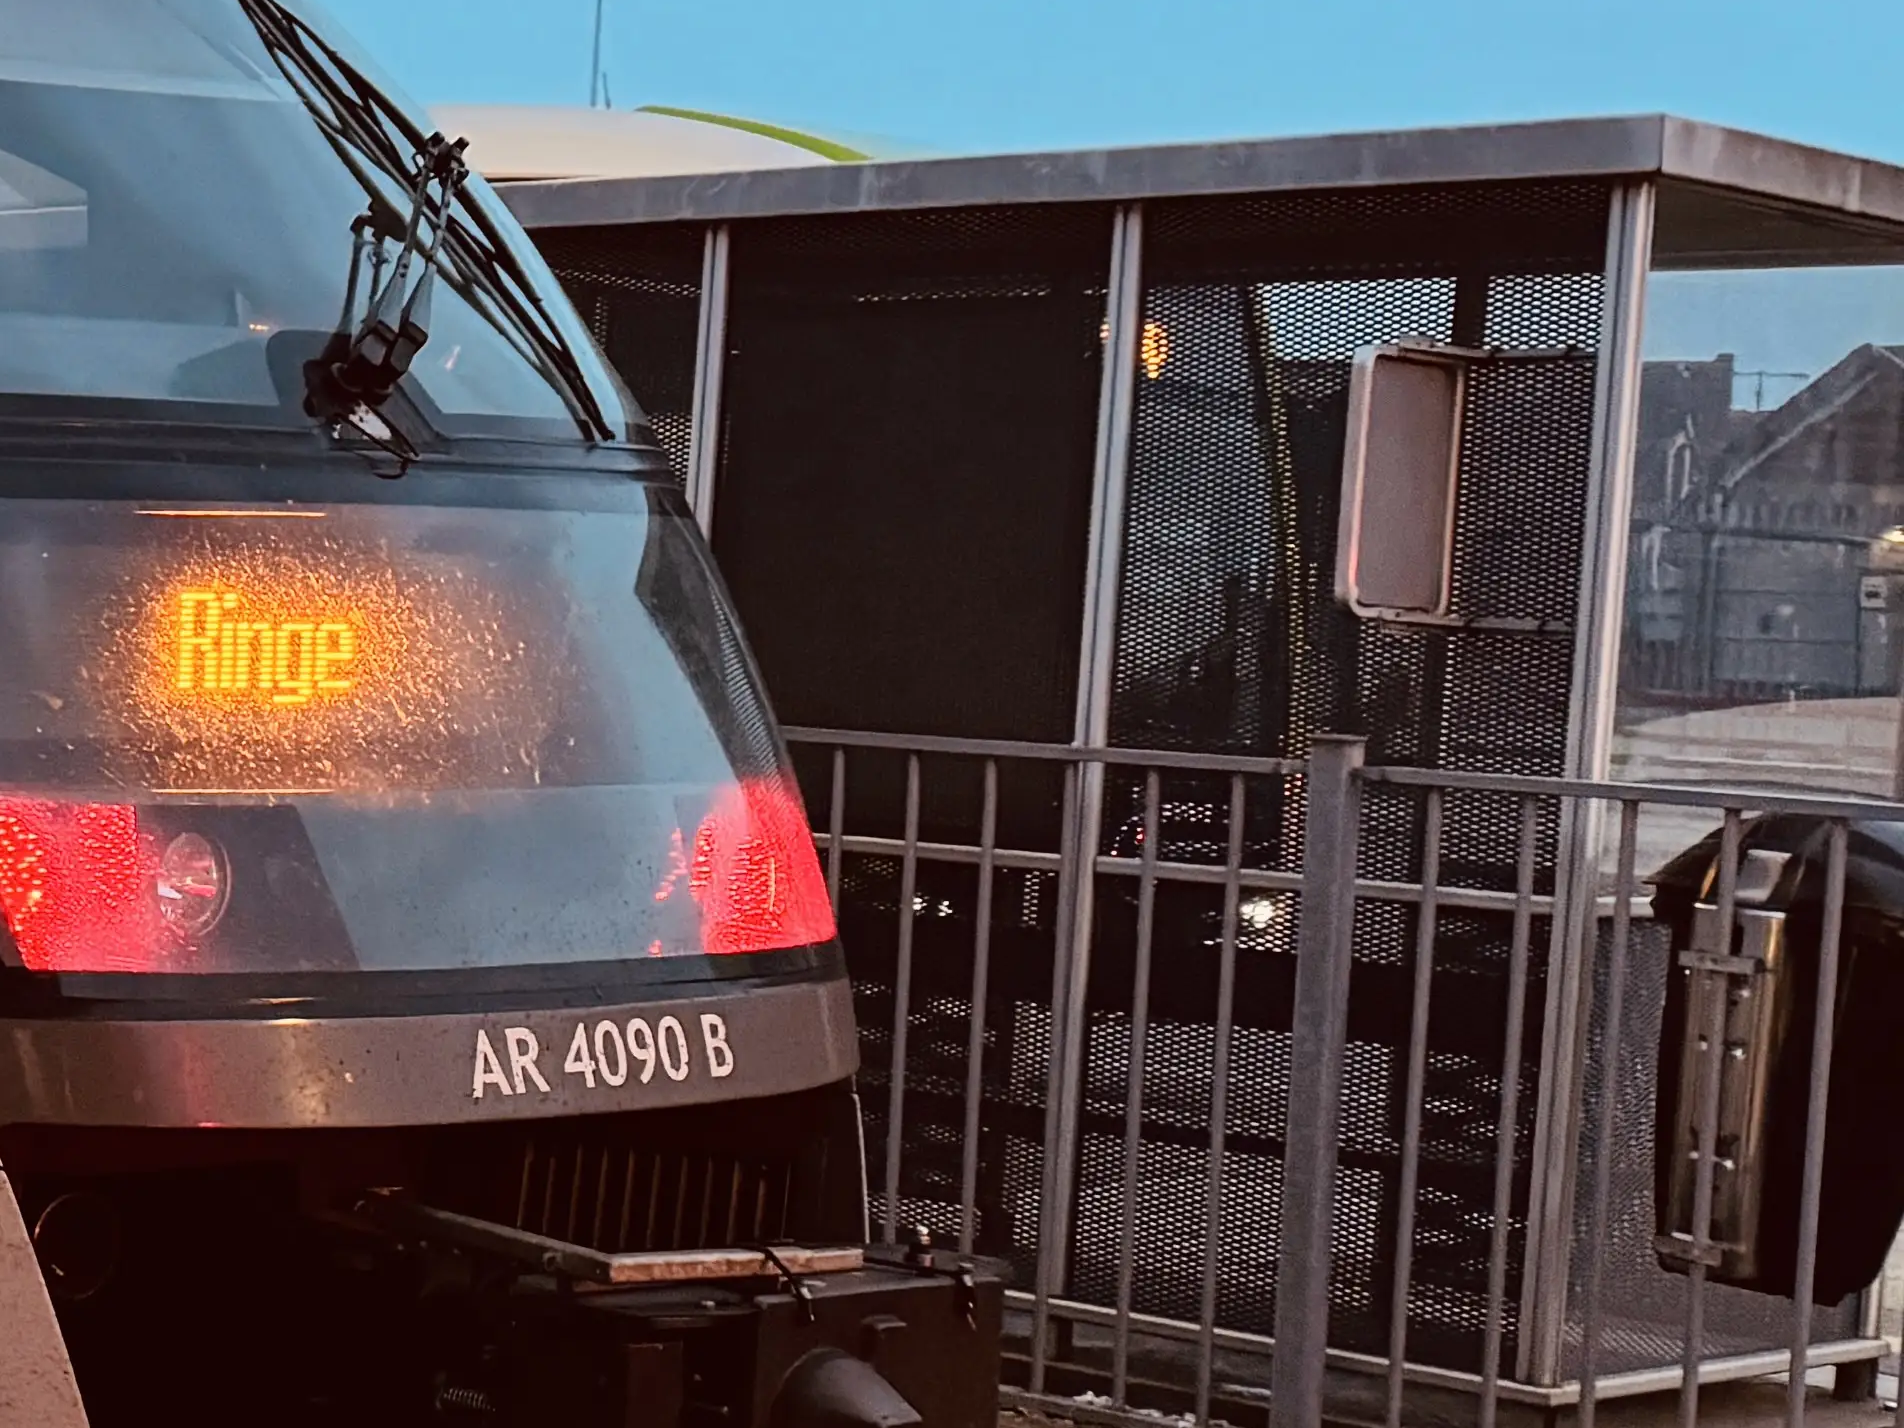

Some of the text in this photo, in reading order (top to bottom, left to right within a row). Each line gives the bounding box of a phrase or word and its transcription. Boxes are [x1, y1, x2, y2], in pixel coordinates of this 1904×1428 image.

[176, 591, 354, 704] Ringe
[472, 1013, 734, 1098] AR 4090 B
